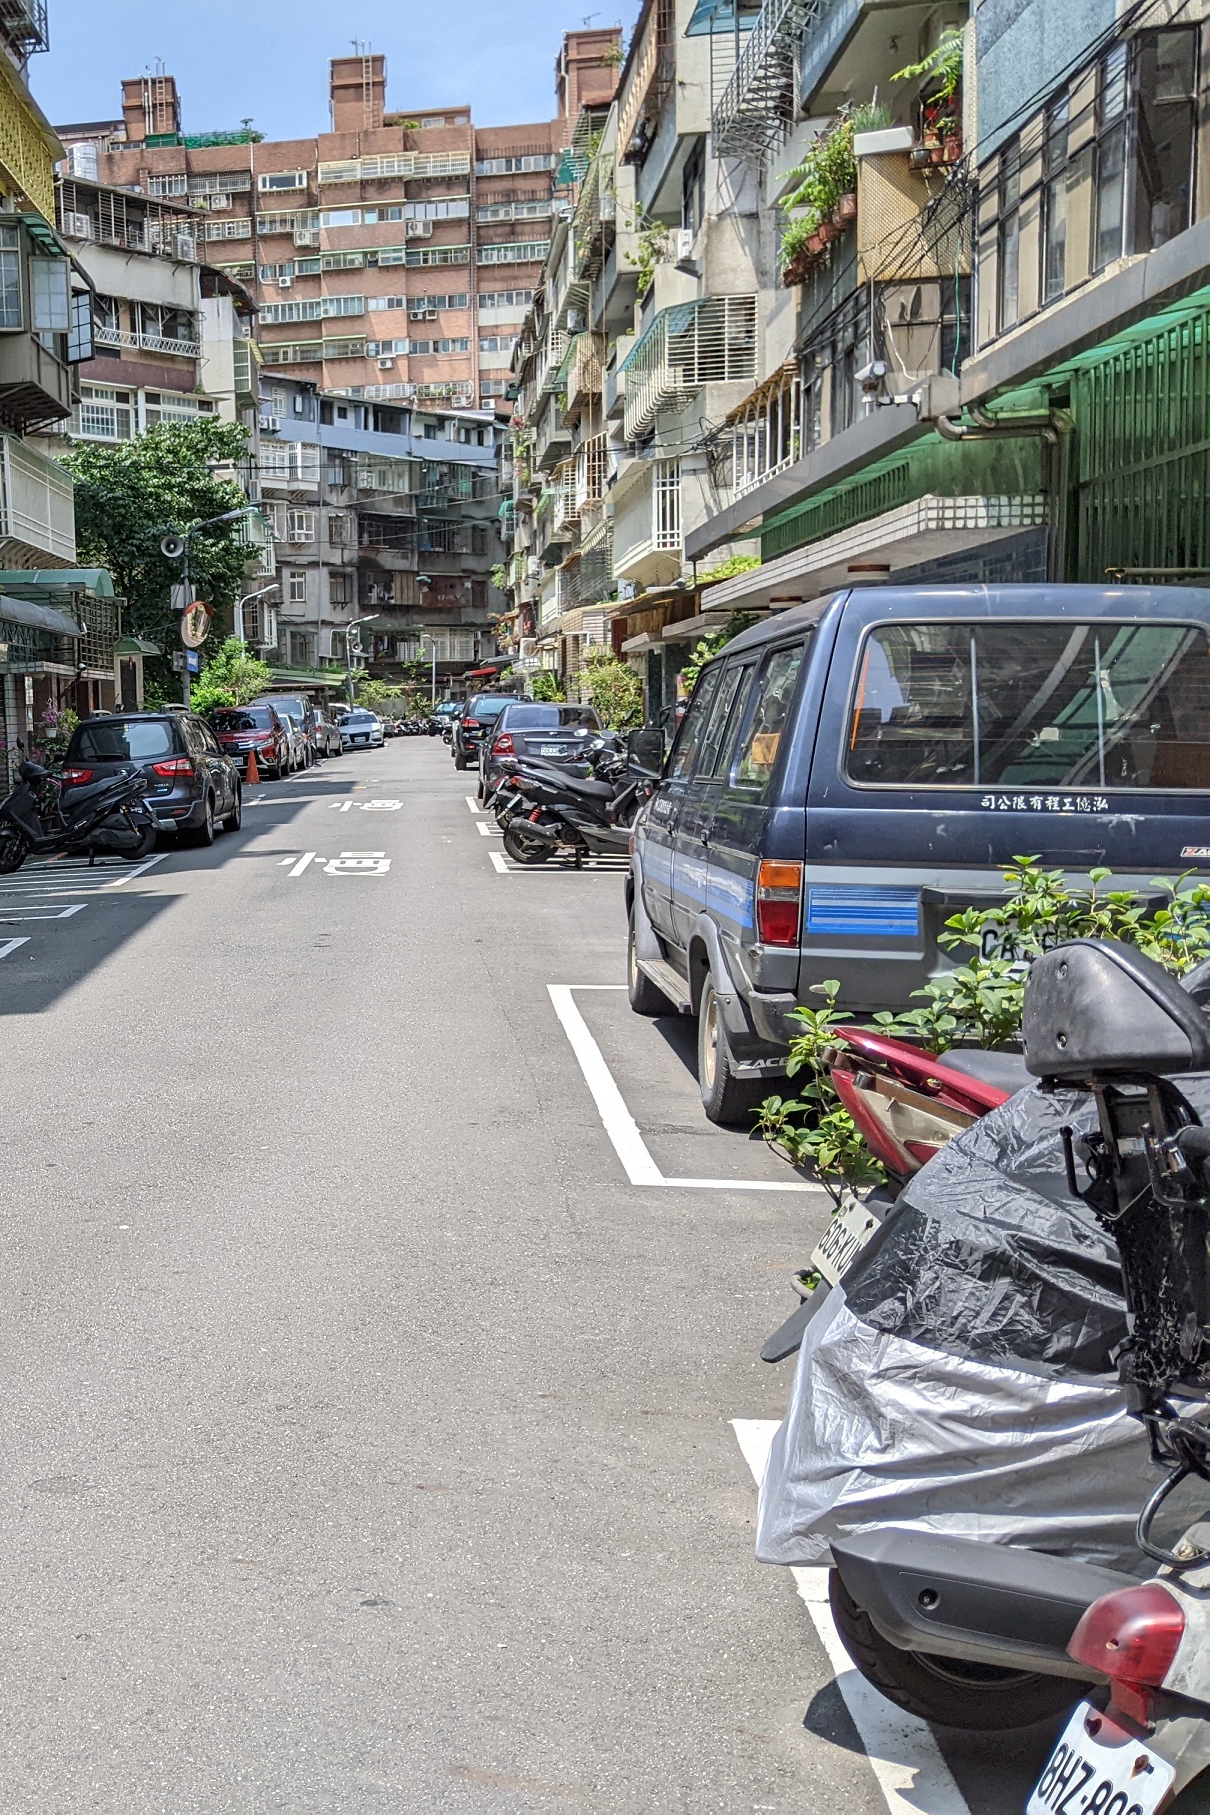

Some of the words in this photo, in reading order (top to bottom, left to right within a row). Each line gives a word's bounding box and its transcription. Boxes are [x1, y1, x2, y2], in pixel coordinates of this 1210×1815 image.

[328, 799, 404, 812] 慢
[276, 851, 392, 877] 慢
[1037, 1742, 1144, 1815] 8HZ-8
